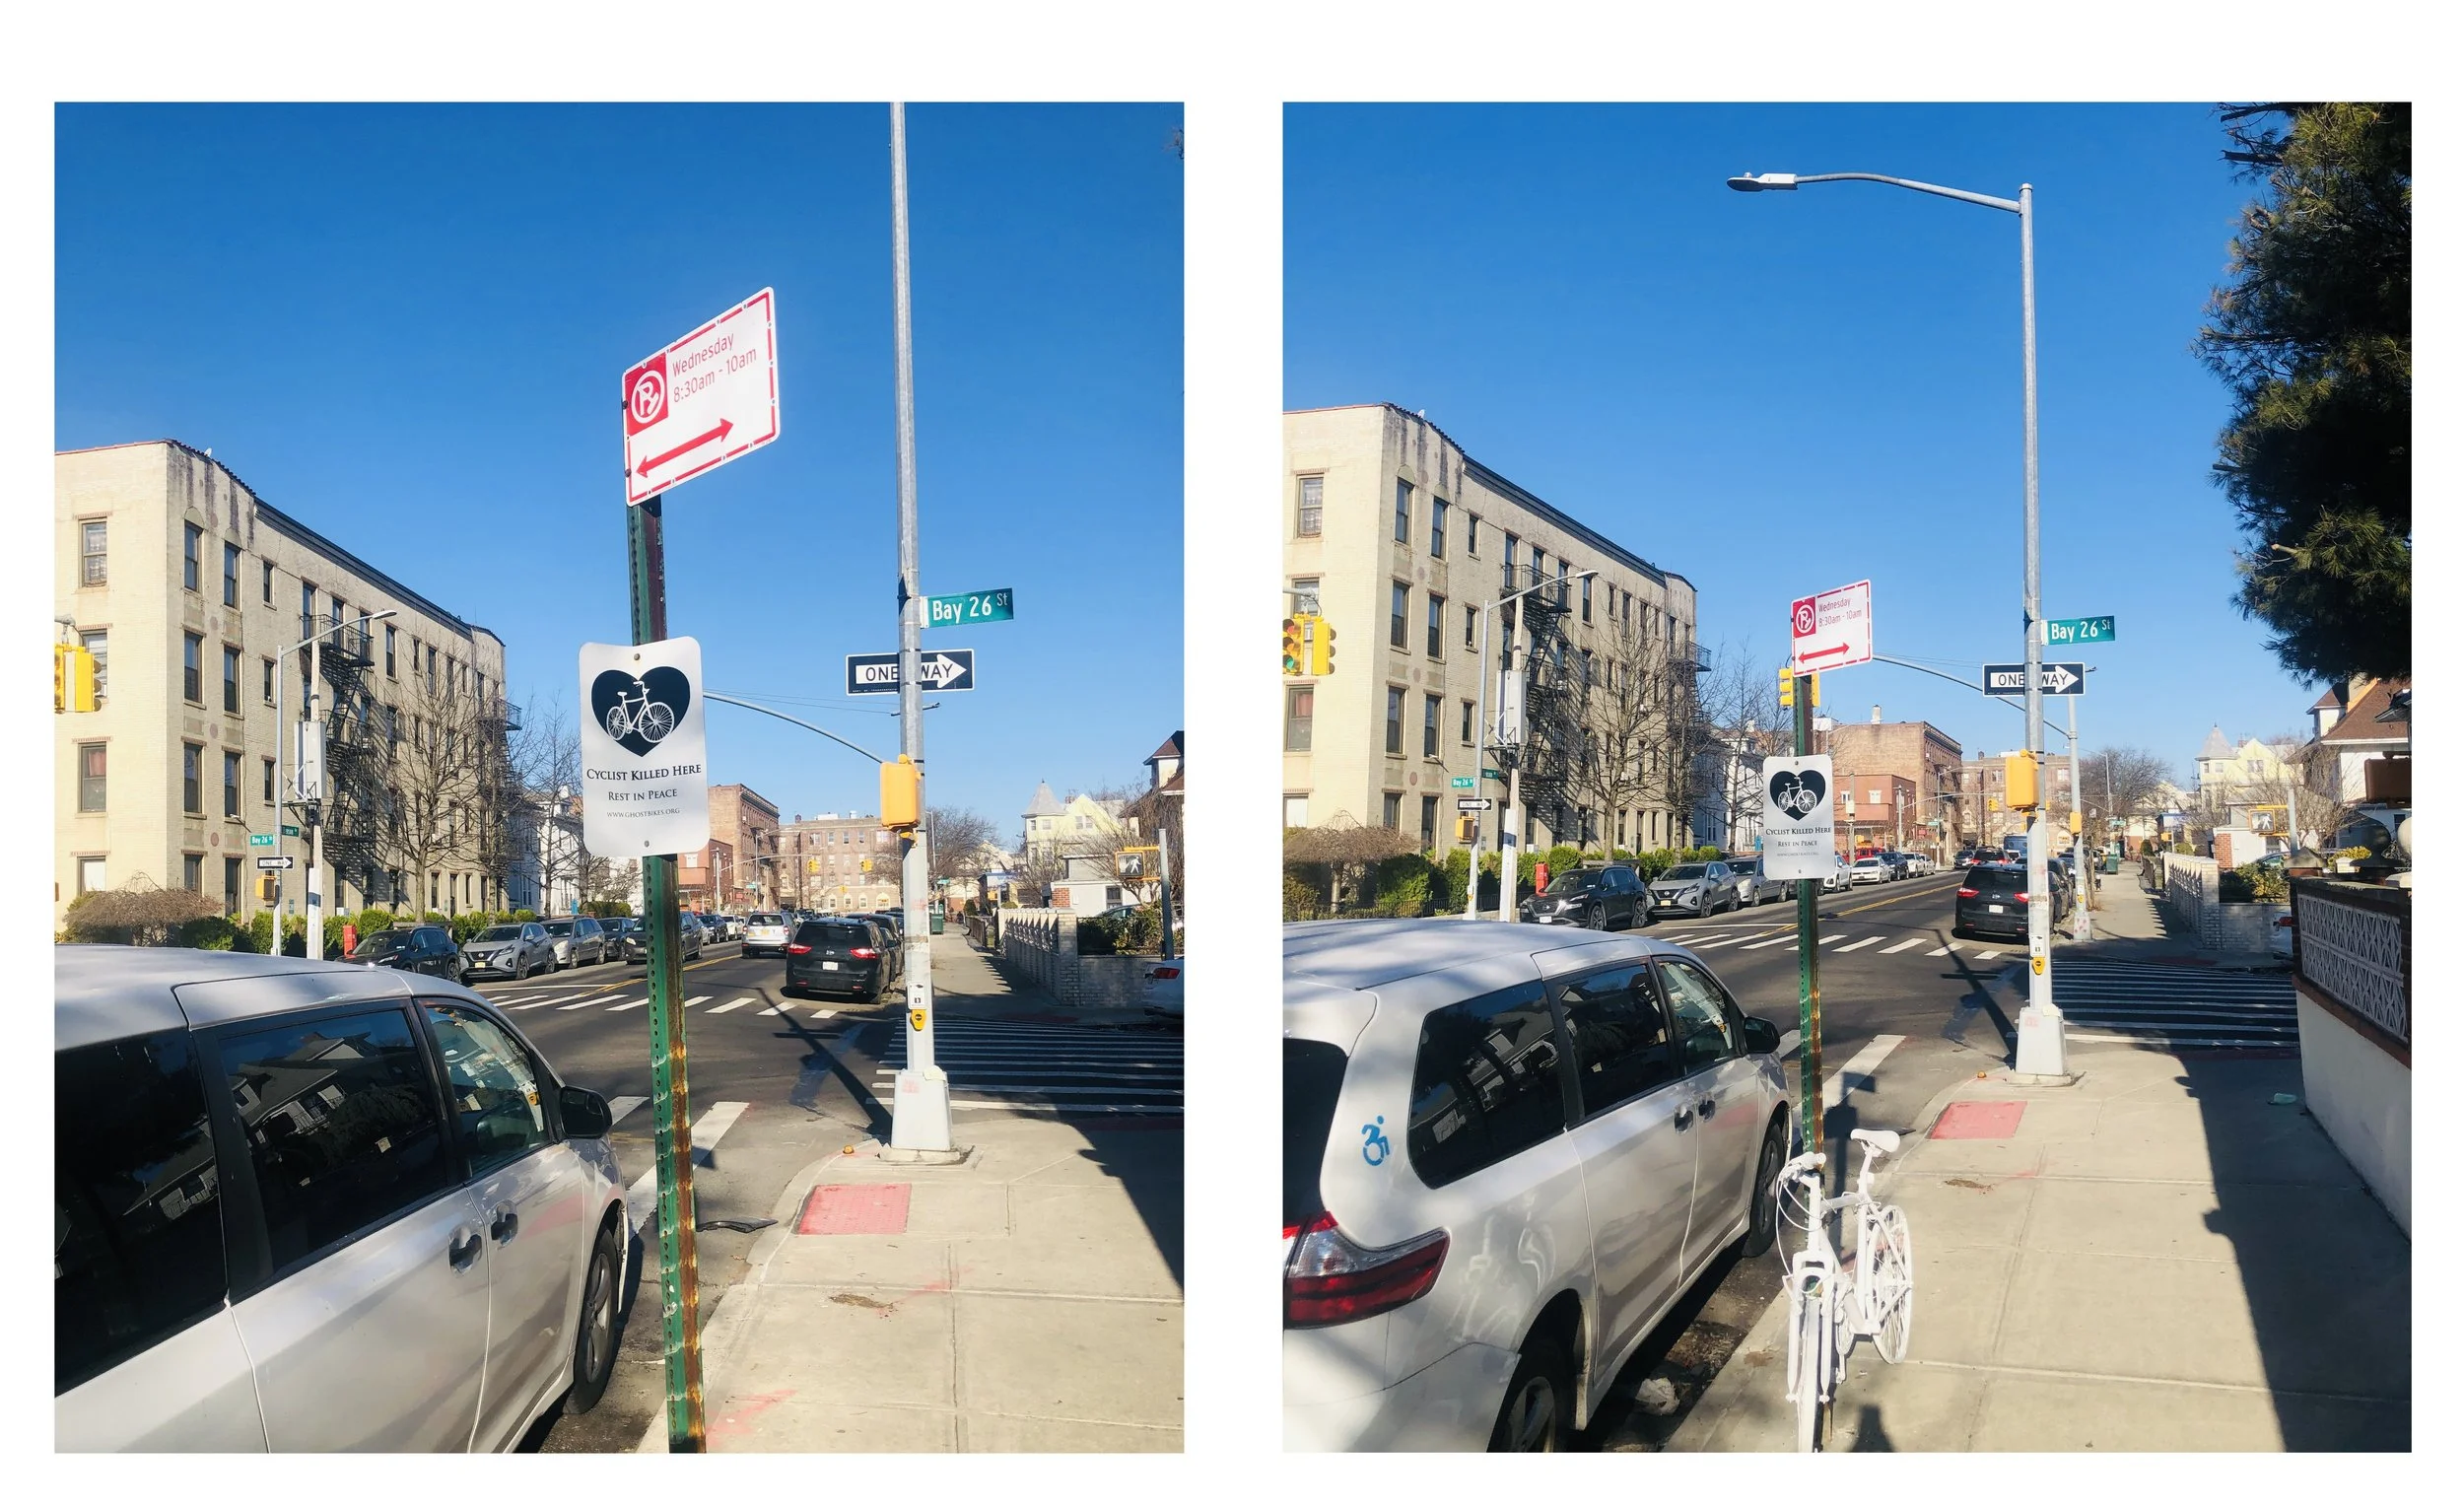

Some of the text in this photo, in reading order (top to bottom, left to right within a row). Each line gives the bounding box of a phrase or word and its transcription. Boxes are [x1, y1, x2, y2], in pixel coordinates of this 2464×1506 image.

[672, 333, 733, 377] Wednesday
[673, 371, 715, 403] 8:30am
[725, 348, 757, 376] 10am
[932, 592, 1008, 624] Bay 26 St
[1817, 597, 1851, 612] Wednesday
[1818, 614, 1841, 628] 8:30am
[1846, 609, 1863, 620] 10am
[2051, 619, 2111, 643] Bay 26 St
[865, 663, 953, 682] ONE WAY
[1998, 673, 2069, 686] ONE WAY
